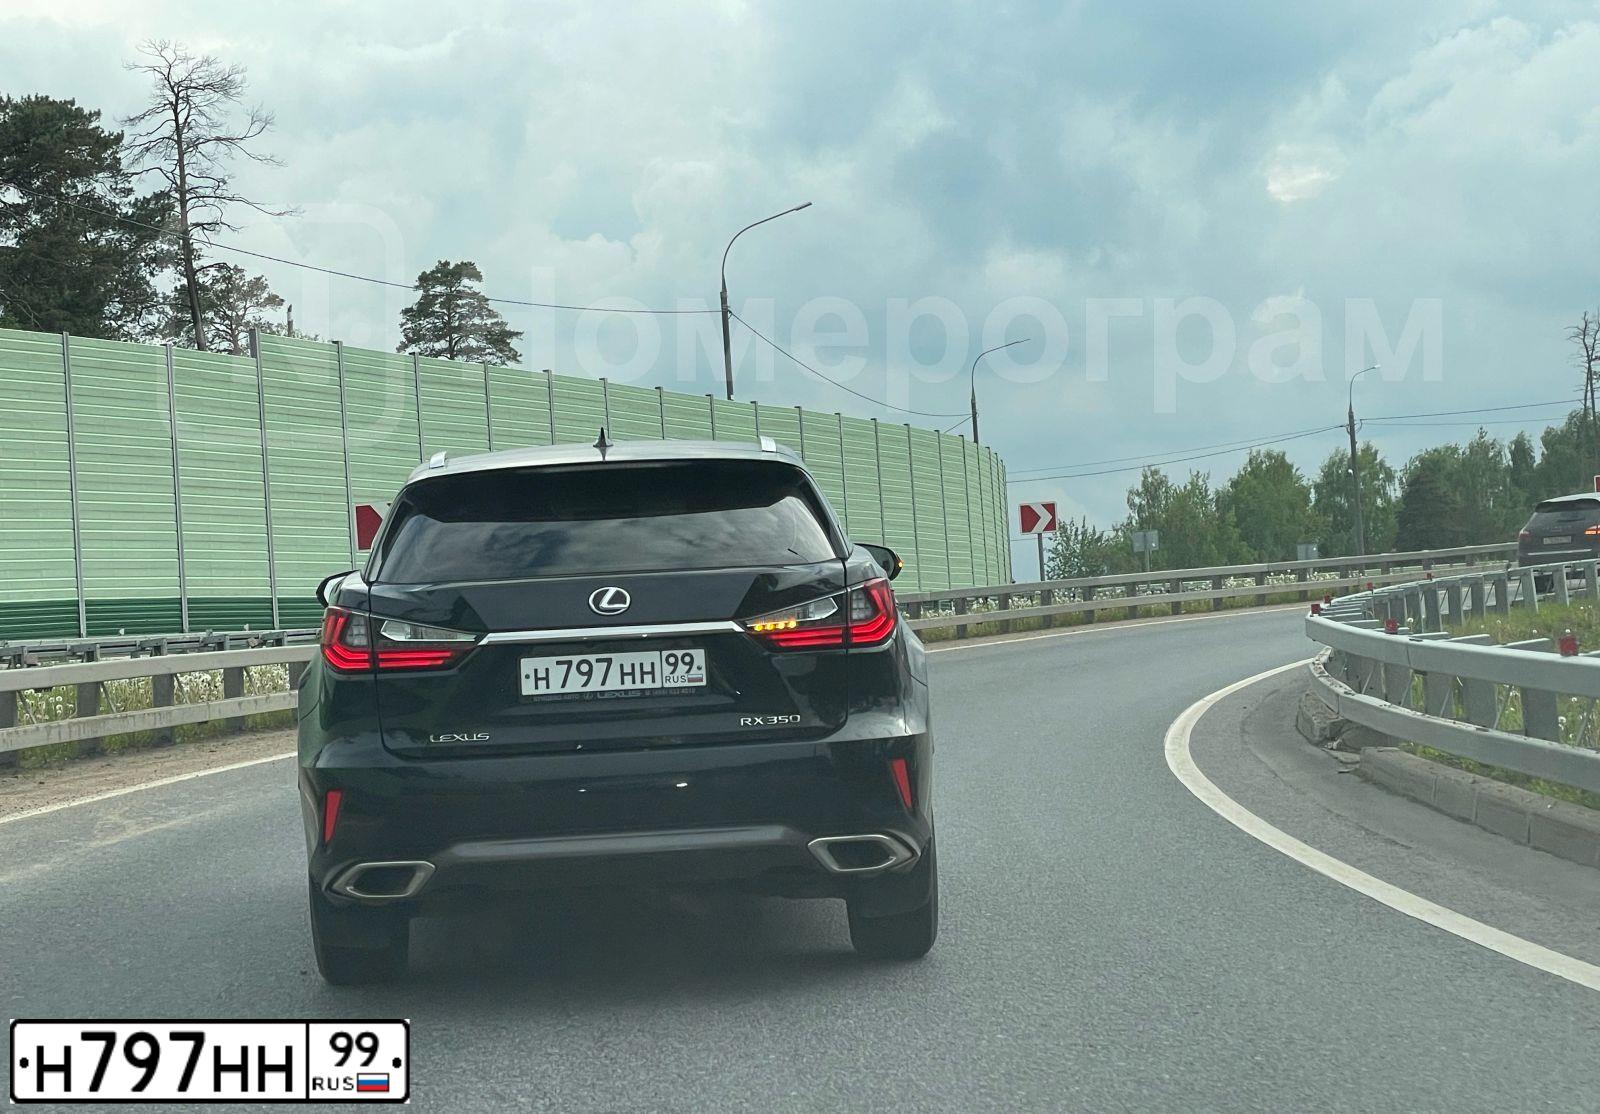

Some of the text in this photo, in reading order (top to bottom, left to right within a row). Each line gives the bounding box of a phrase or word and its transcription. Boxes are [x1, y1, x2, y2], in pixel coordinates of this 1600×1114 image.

[664, 652, 695, 675] 99
[664, 674, 687, 684] RUS
[740, 714, 801, 726] RX 350
[430, 732, 490, 743] LEXUS
